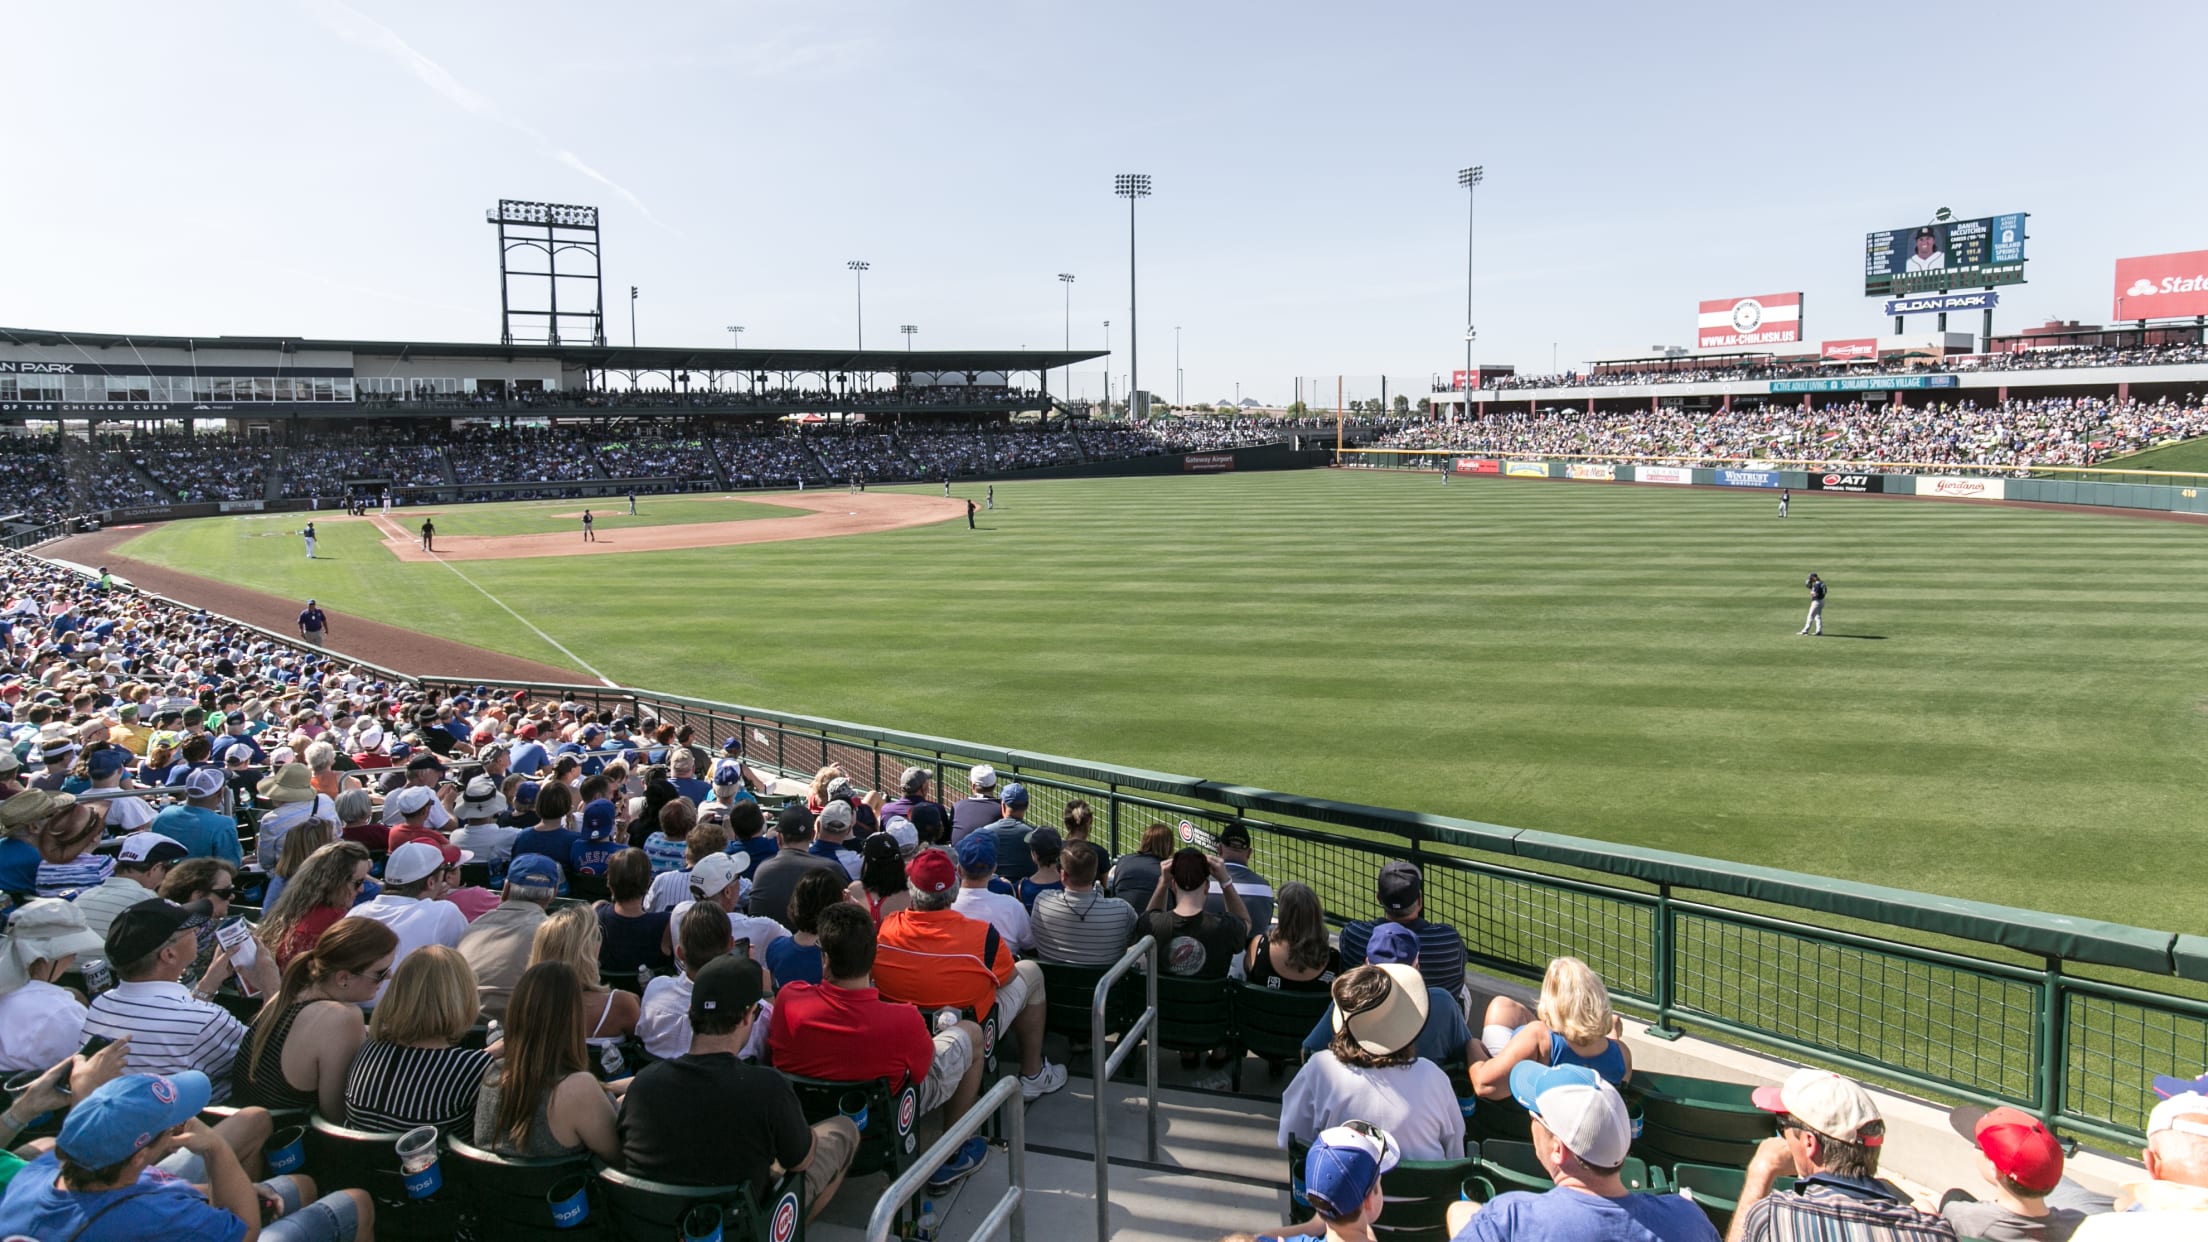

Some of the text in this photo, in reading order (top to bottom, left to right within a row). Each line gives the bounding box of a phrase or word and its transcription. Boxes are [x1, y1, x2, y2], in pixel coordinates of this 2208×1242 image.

[1950, 227, 1986, 236] MCCUTCHEN
[1958, 222, 1979, 230] DANIEL
[2159, 274, 2208, 294] State
[1895, 296, 1985, 312] SLOAN PARK
[1701, 330, 1794, 347] WWW.AK-CHIN.NSN.US
[21, 363, 75, 373] PARK
[1773, 377, 1920, 391] ACTIVE ADULT LIVING SUNLAND SPRINGS VILLAGE
[1725, 471, 1769, 482] WINTRUST
[1841, 476, 1868, 485] ATI
[1936, 480, 1984, 492] Giordano's
